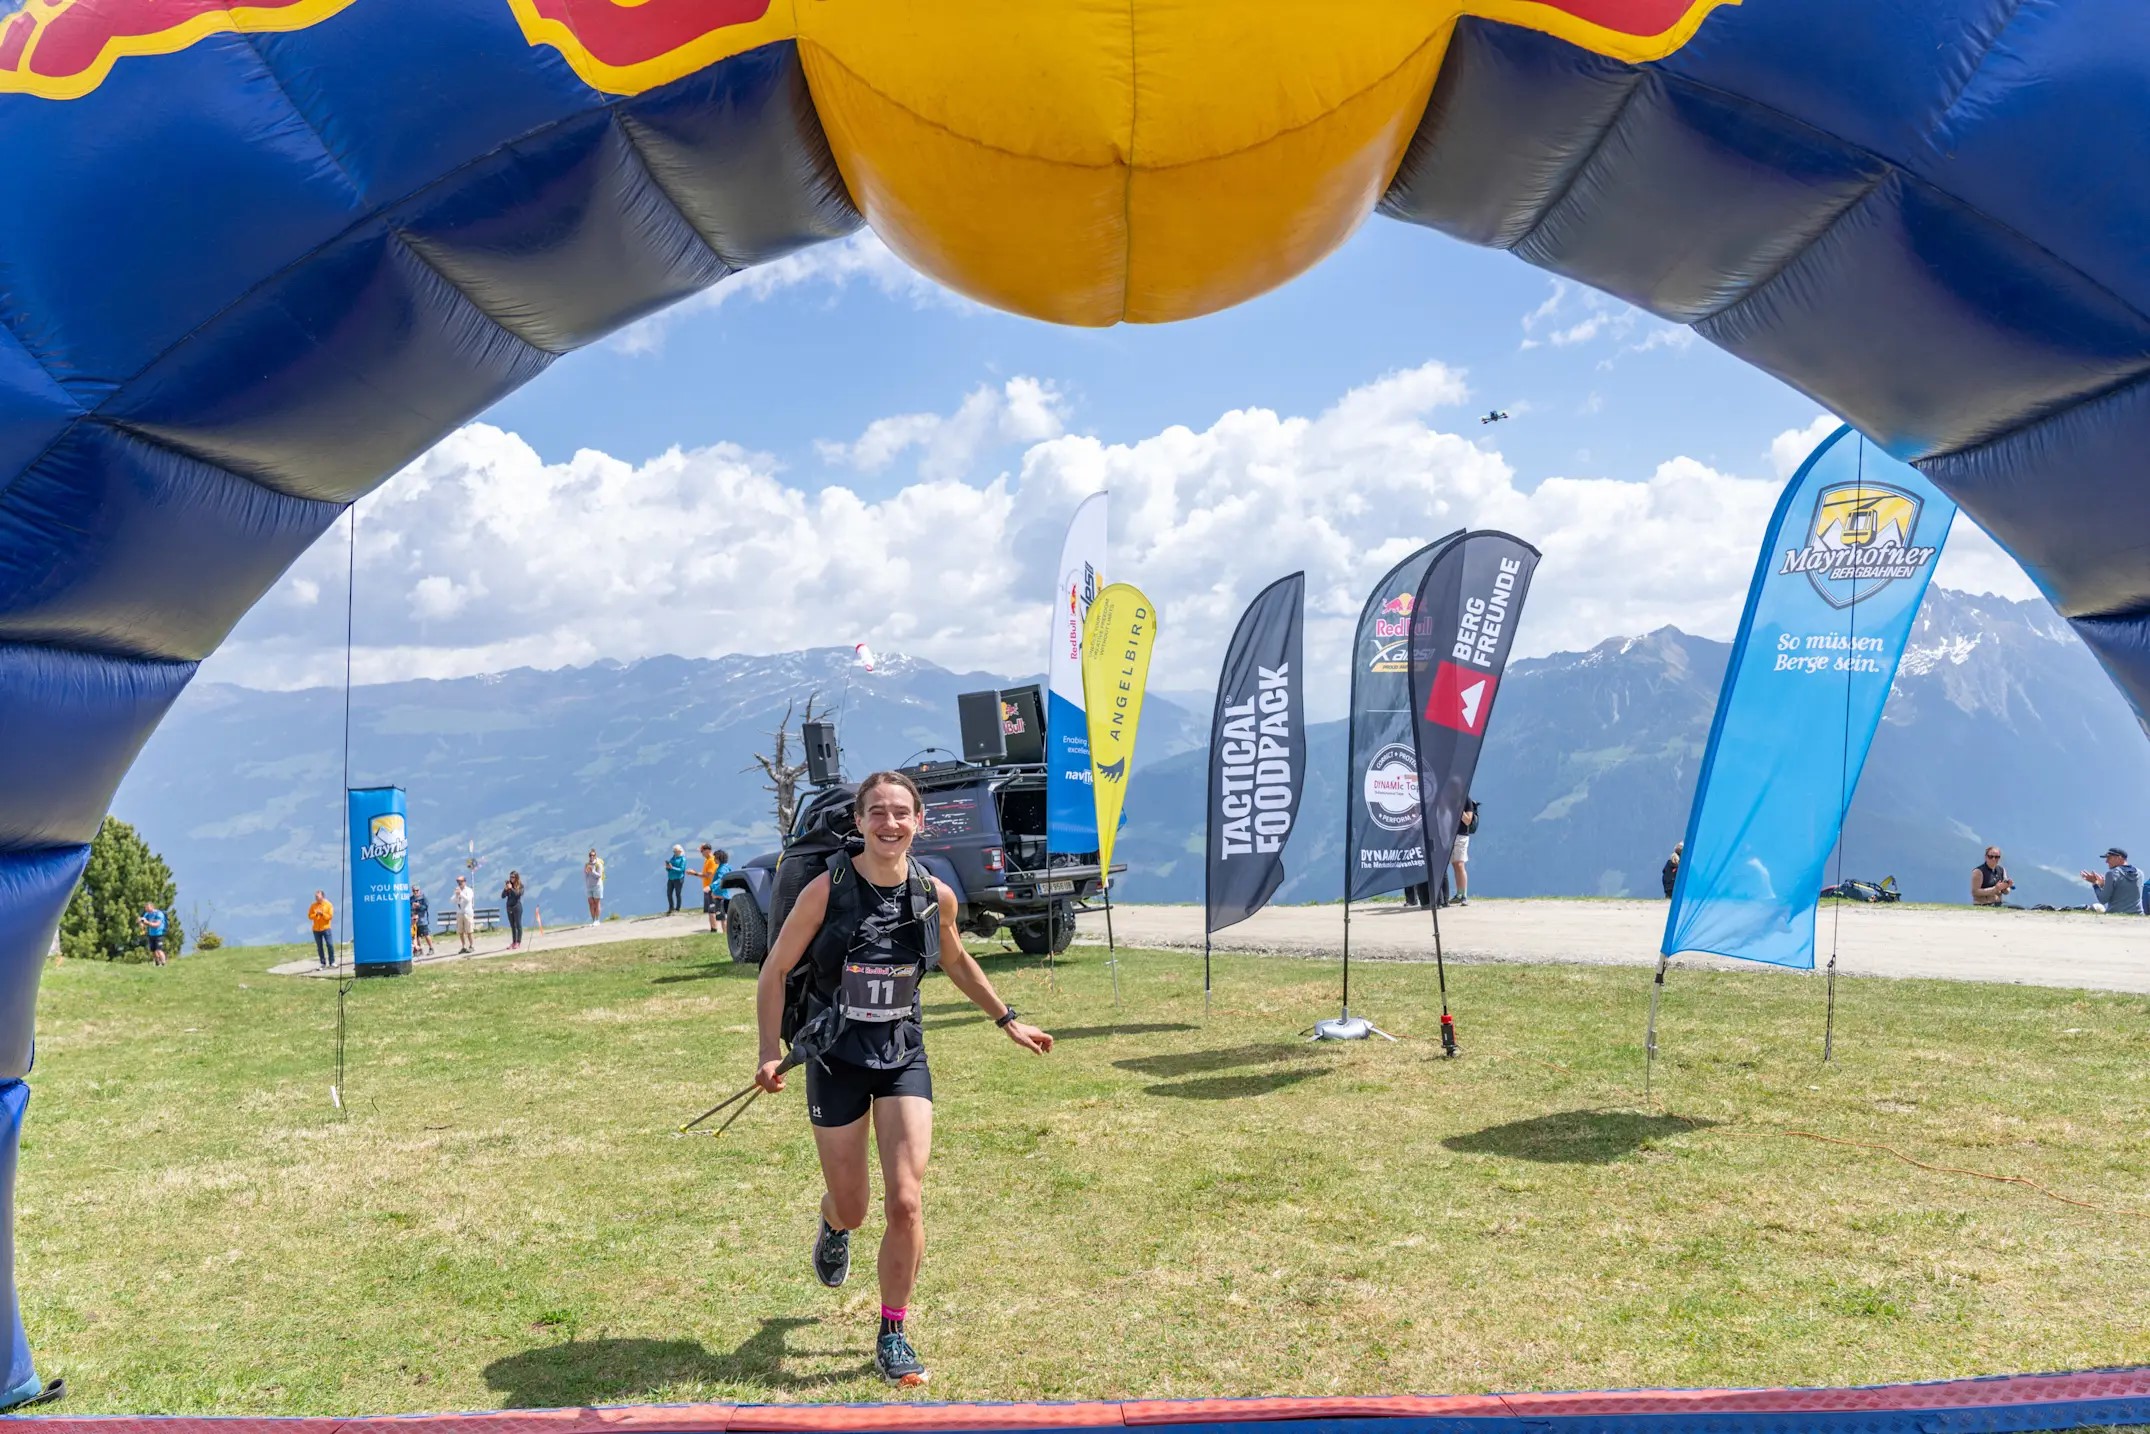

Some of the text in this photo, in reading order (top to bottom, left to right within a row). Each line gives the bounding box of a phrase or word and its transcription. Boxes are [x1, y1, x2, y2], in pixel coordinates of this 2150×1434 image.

[1780, 541, 1935, 574] Mayrhofner
[1830, 567, 1914, 580] BERGBAHNEN
[1472, 557, 1521, 668] FREUNDE
[1376, 617, 1405, 638] Red
[1452, 597, 1486, 661] BERG
[1777, 632, 1884, 651] So müssen
[1774, 654, 1880, 674] Berge sein.
[1110, 607, 1146, 742] ANGELBIRD
[1006, 717, 1025, 735] Bull
[1254, 662, 1293, 854] FOODPACK
[1222, 695, 1257, 861] TACTICAL
[1382, 814, 1412, 824] PERFORM
[1361, 848, 1403, 861] DYNAMIC
[1361, 860, 1372, 869] The
[364, 893, 399, 902] REALLY
[370, 883, 390, 893] YOU
[867, 979, 895, 1005] 11
